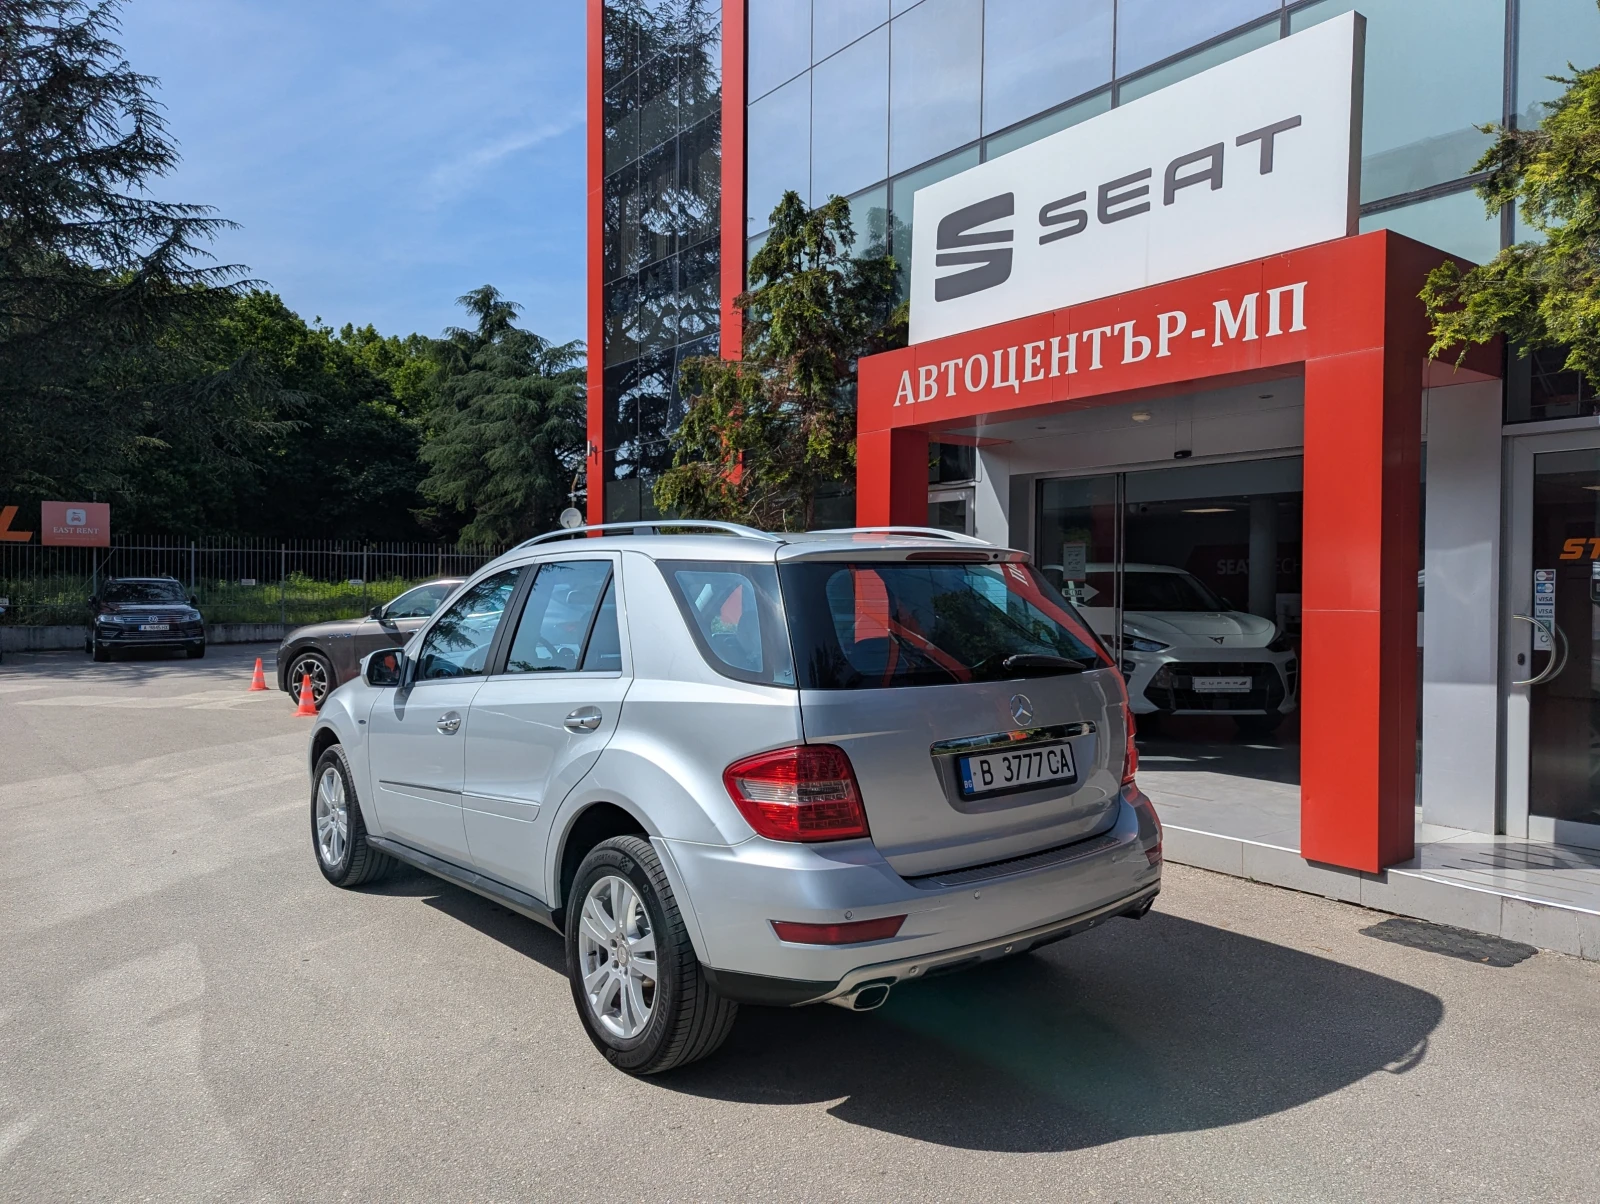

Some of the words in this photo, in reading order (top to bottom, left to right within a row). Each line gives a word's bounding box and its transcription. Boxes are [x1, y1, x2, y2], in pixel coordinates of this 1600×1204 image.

[1038, 114, 1302, 247] SEAT
[893, 280, 1308, 407] АВТОЦЕНТЪР-МП
[53, 526, 76, 534] EAST
[76, 527, 100, 536] RENT
[1217, 558, 1250, 575] SEA
[980, 759, 994, 786] B
[1002, 752, 1043, 783] 3777
[1047, 748, 1070, 775] CA
[963, 779, 973, 788] BG
